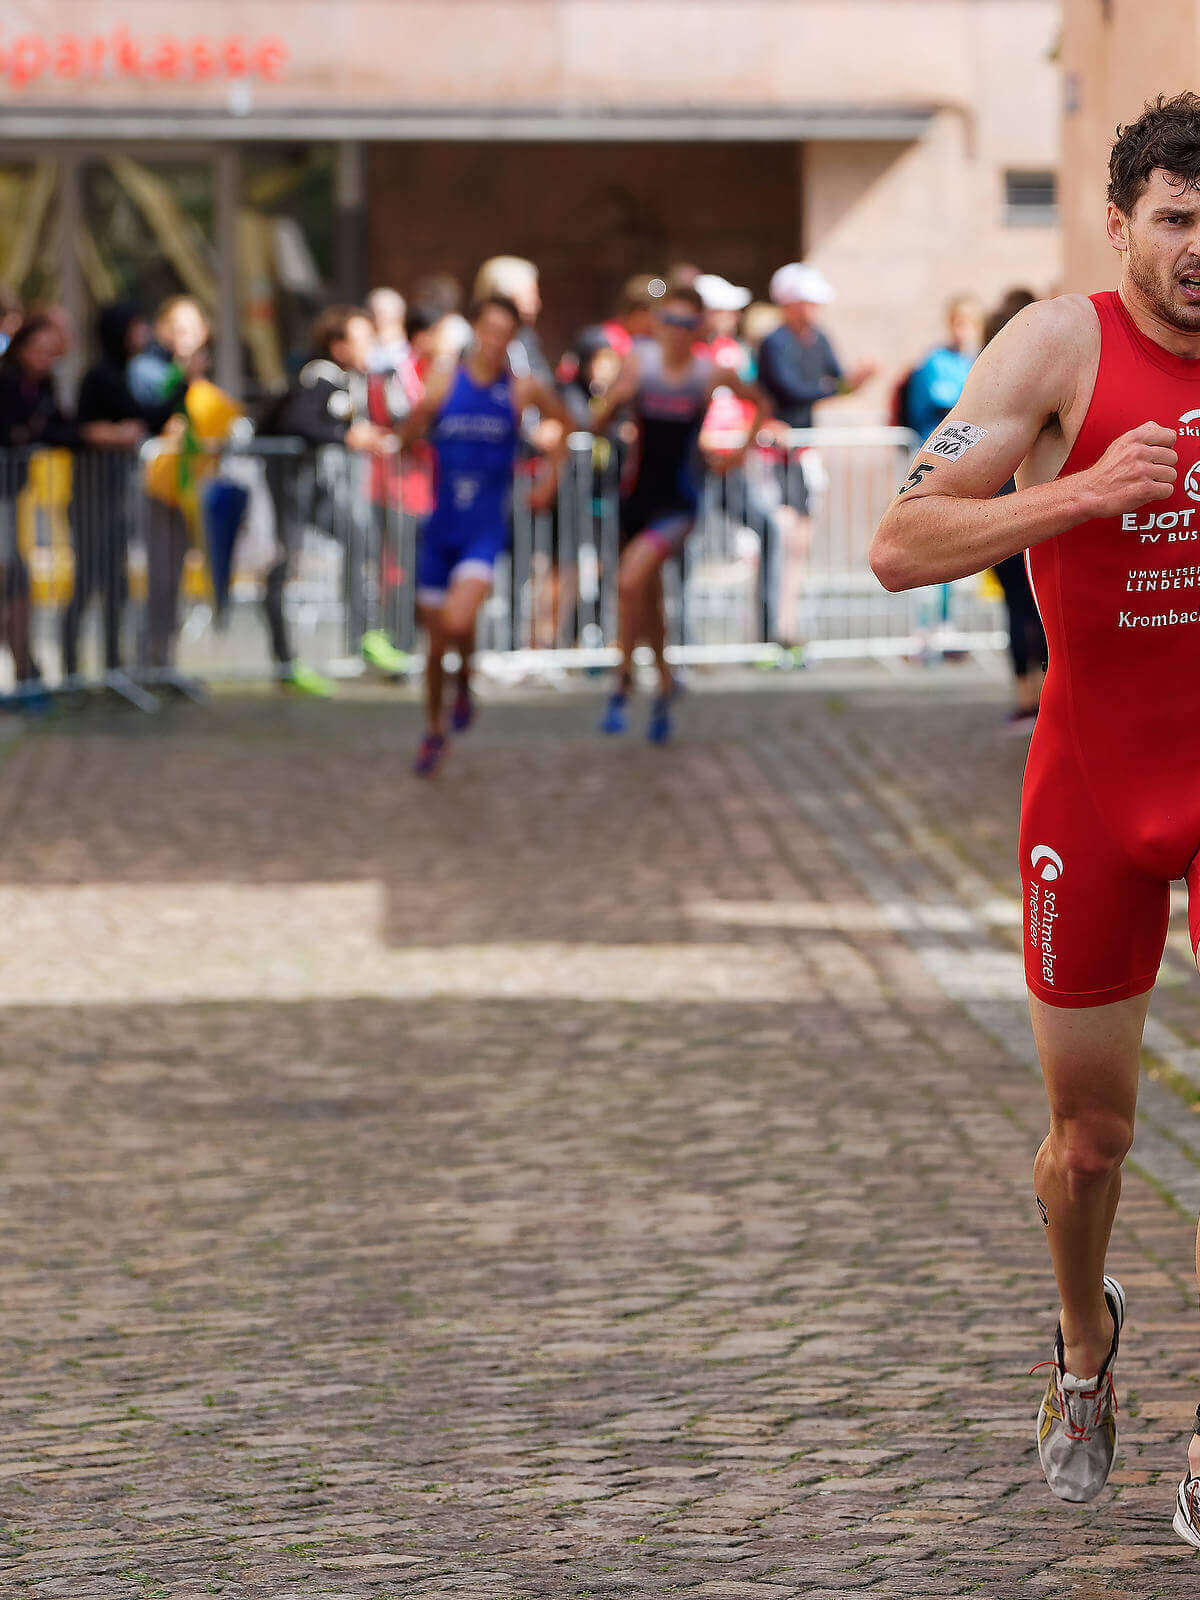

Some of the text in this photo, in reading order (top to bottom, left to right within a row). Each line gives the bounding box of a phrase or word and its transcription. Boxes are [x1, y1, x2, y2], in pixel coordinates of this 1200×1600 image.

[0, 23, 289, 91] parkasse
[899, 463, 936, 495] 5
[1122, 508, 1196, 531] EJOT
[1140, 534, 1161, 543] TV
[1030, 880, 1041, 947] medien
[1042, 889, 1059, 986] schmelzer
